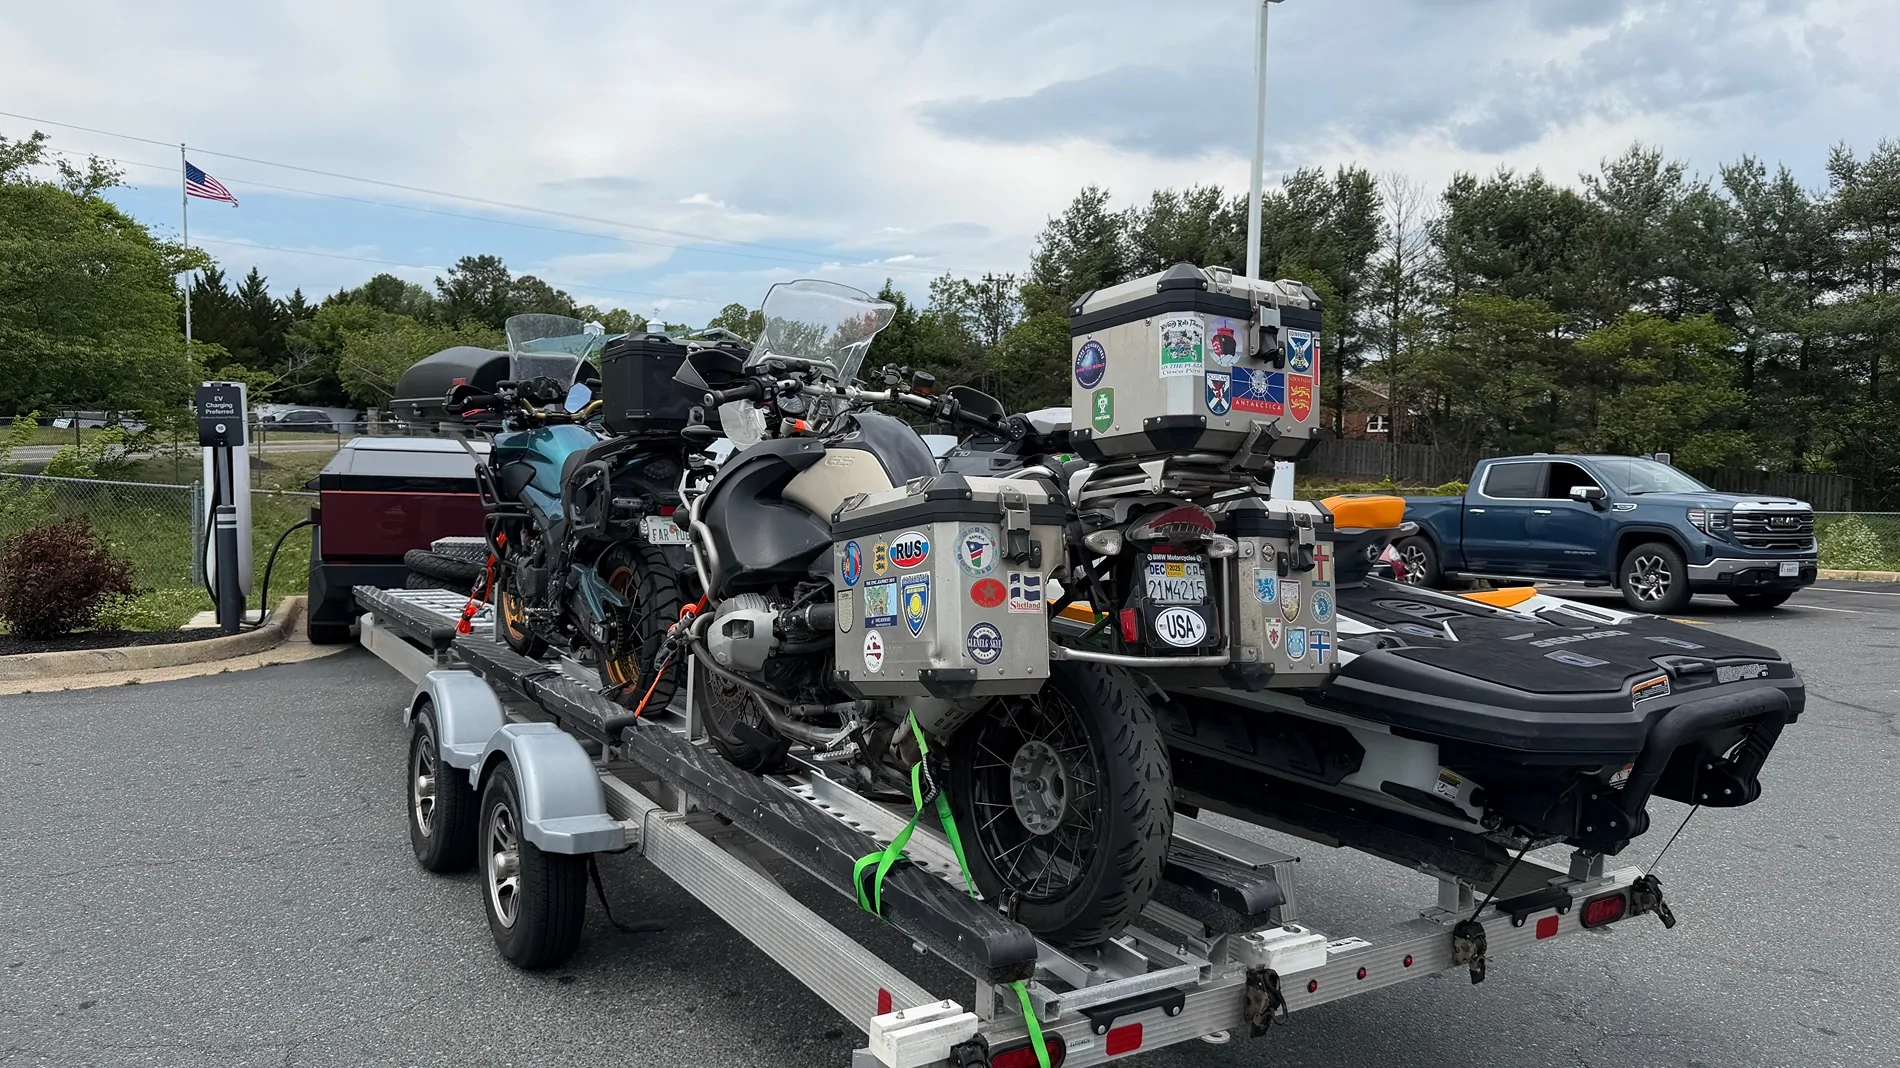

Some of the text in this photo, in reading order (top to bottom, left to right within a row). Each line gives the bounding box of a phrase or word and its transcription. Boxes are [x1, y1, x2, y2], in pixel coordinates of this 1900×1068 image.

[1235, 400, 1282, 411] ANTARCTICA
[652, 528, 670, 541] FAR
[896, 539, 922, 560] RUS
[1167, 554, 1196, 562] Motorcycles
[1150, 564, 1165, 575] DEC
[1169, 564, 1181, 572] 2025
[1148, 580, 1206, 601] 21M4215
[1010, 601, 1041, 610] Shetland
[1166, 614, 1196, 638] USA
